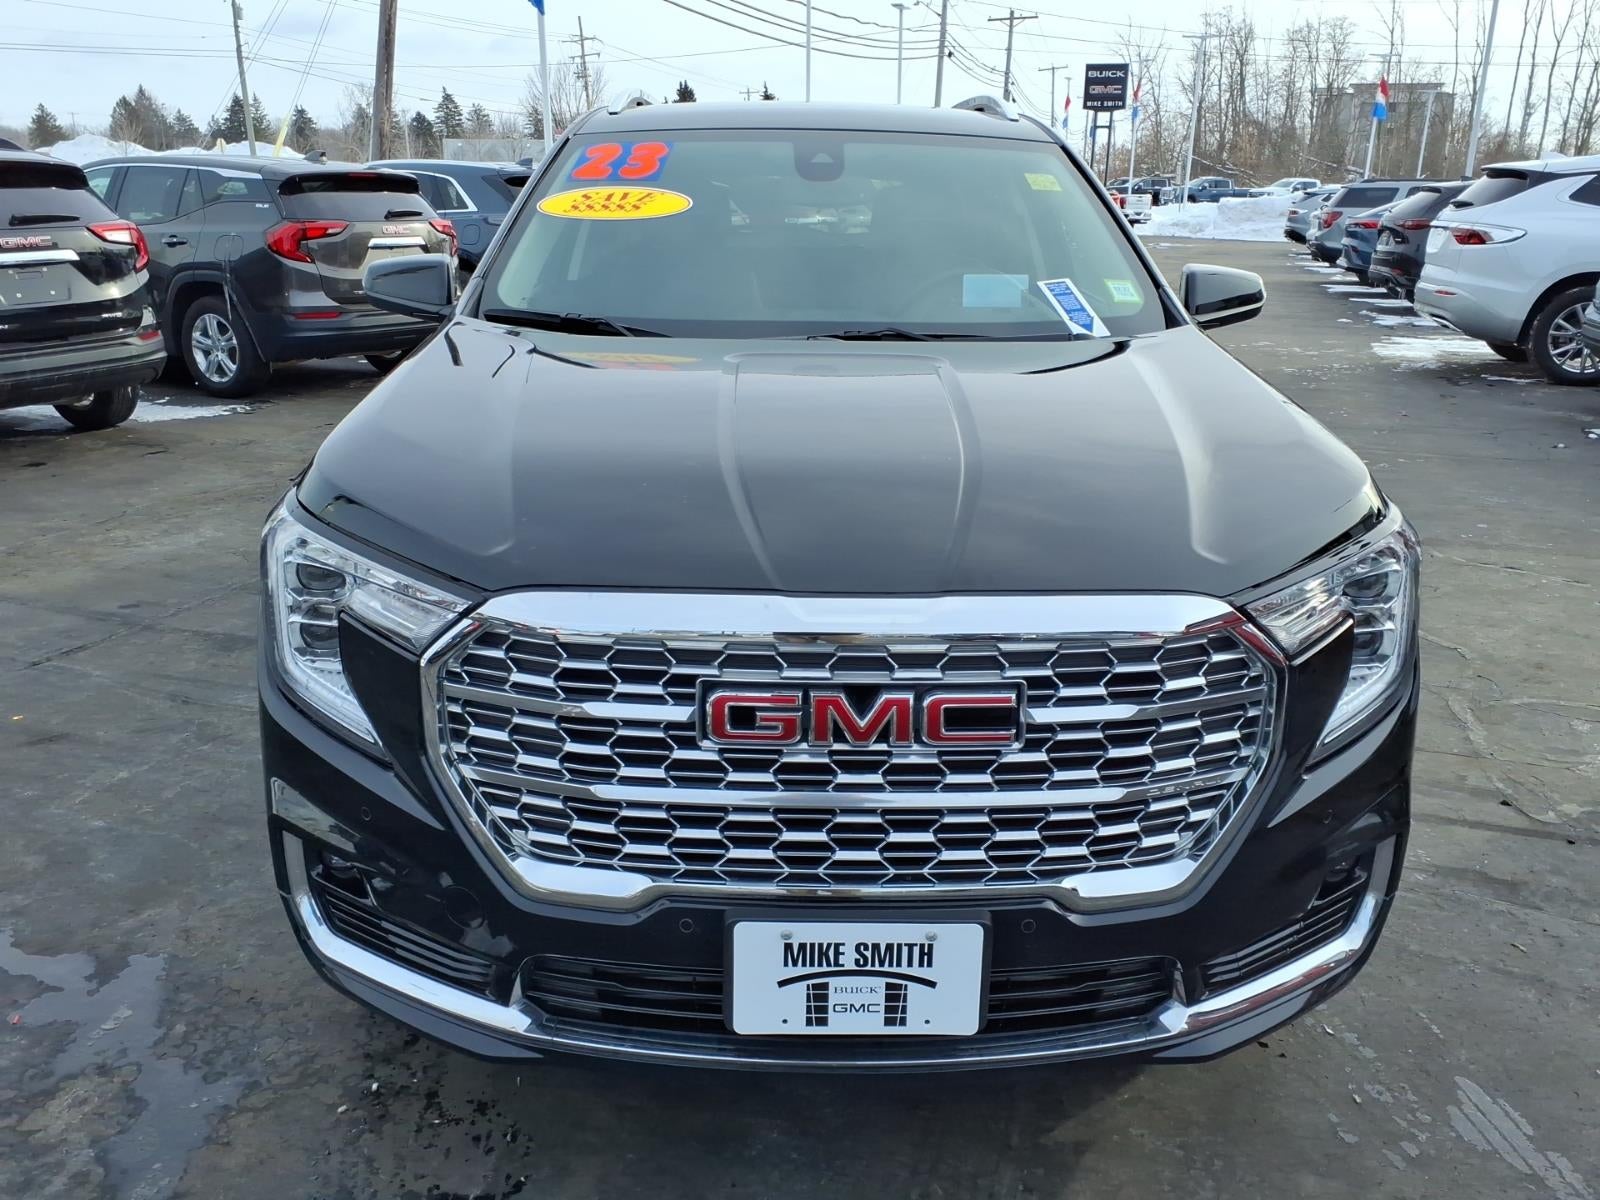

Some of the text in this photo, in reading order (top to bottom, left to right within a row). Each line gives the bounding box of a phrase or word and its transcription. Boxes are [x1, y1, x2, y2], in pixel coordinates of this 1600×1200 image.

[1089, 85, 1122, 94] GMC
[571, 142, 670, 181] 23
[573, 191, 658, 204] SAVE
[383, 225, 410, 234] GMC
[0, 235, 52, 248] GMC
[706, 690, 1017, 746] GMC
[783, 942, 934, 968] MIKE SMITH
[833, 986, 878, 994] BUICK
[833, 1003, 881, 1013] GMC
